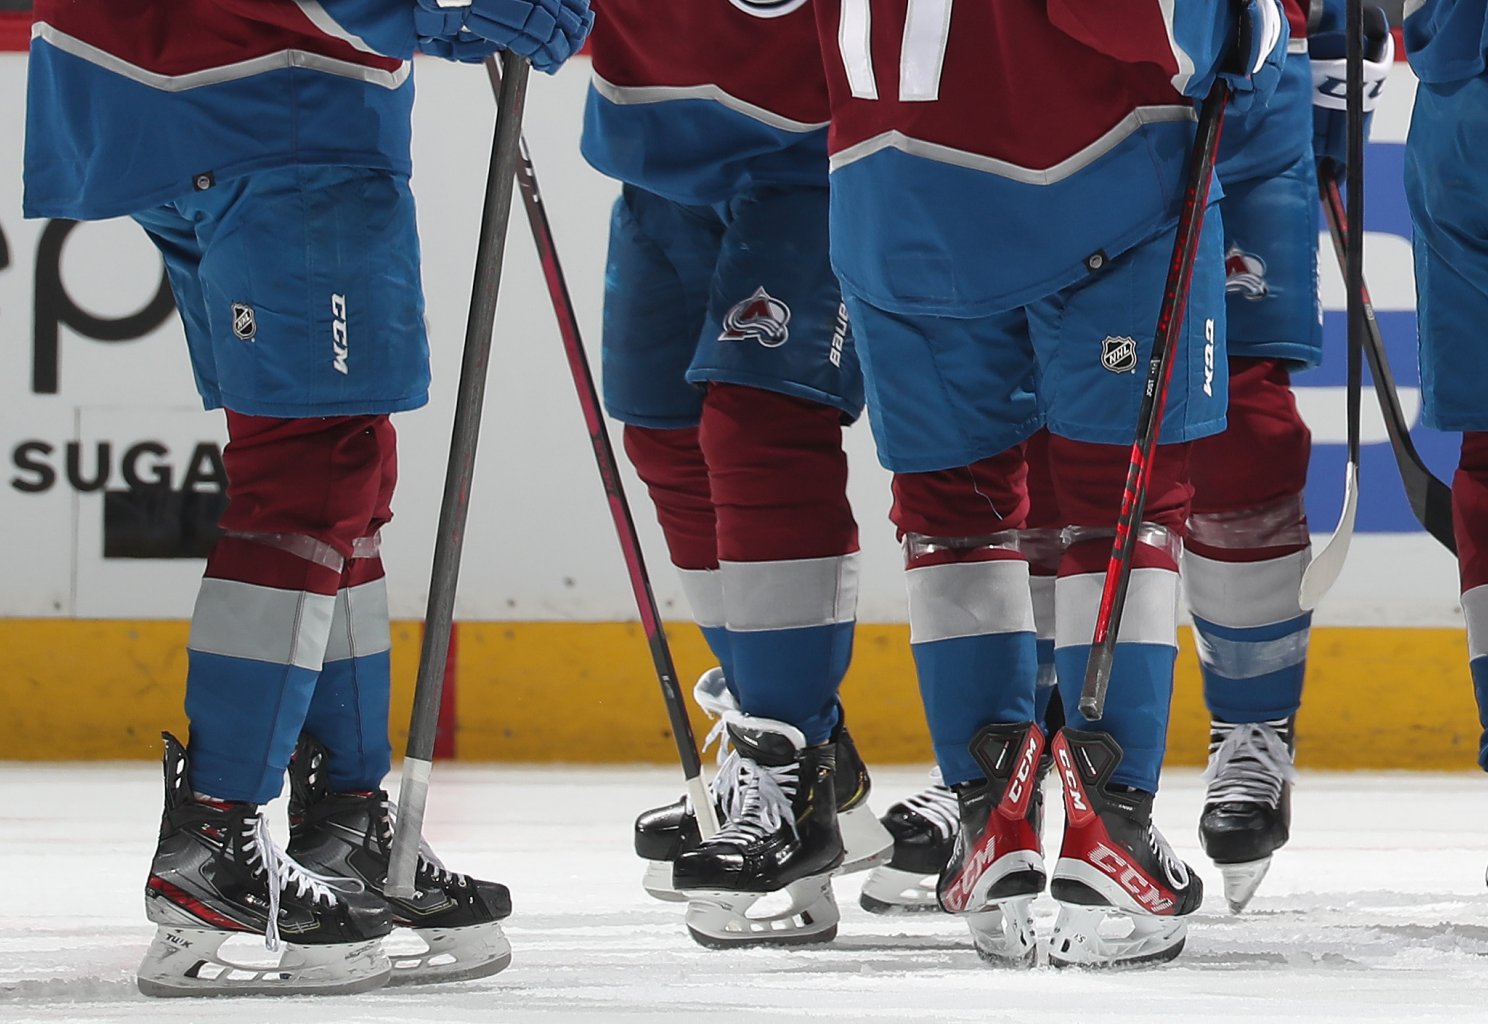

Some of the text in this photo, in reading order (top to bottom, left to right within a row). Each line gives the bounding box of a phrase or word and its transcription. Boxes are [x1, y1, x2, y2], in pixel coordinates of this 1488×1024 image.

[332, 293, 349, 376] CCM
[1203, 318, 1215, 398] CCM
[1008, 737, 1037, 804] CCM
[1058, 748, 1087, 811] CCM
[945, 835, 998, 912] CCM
[1088, 842, 1174, 914] CCM
